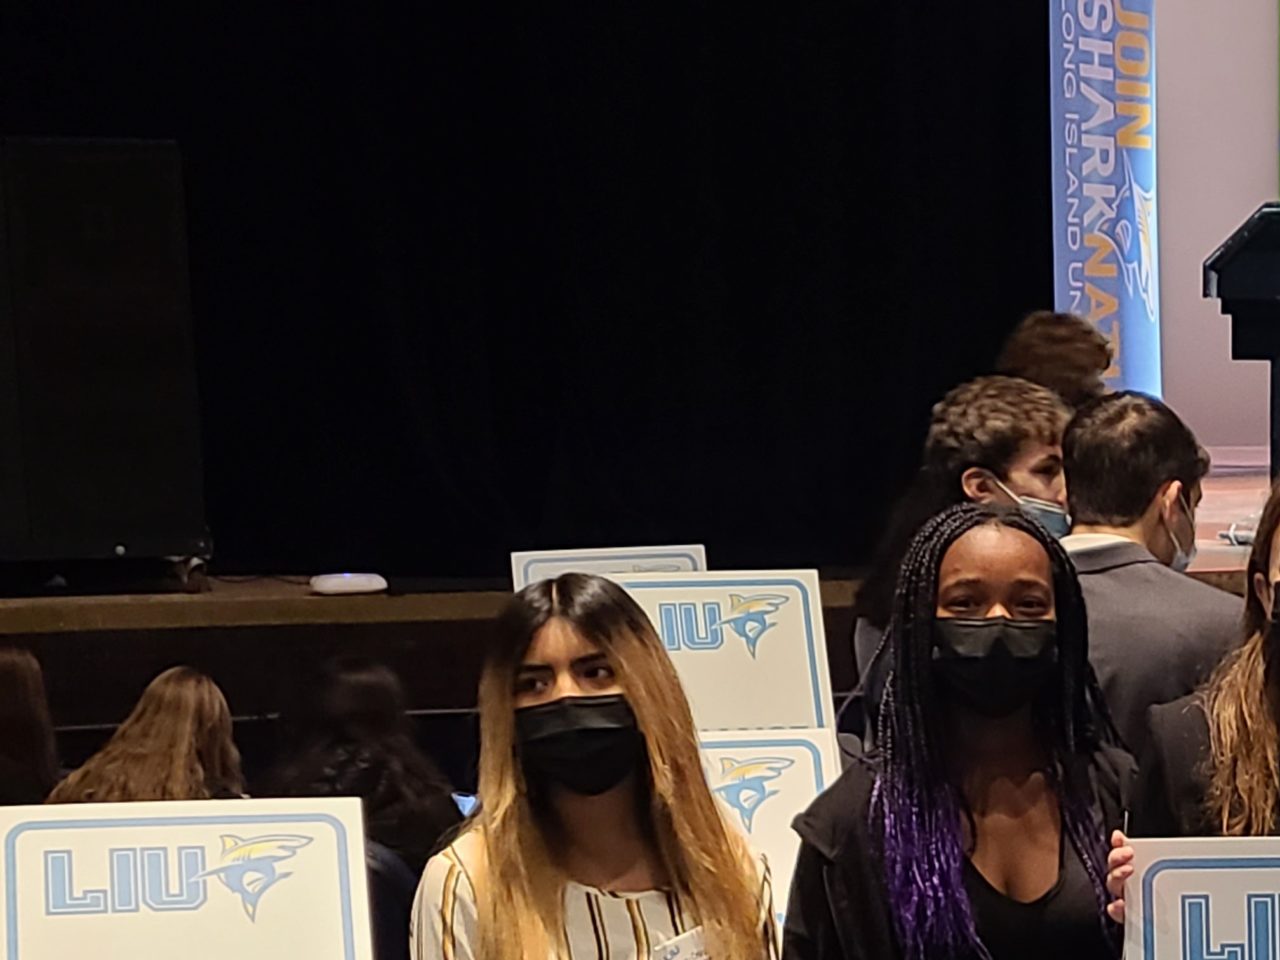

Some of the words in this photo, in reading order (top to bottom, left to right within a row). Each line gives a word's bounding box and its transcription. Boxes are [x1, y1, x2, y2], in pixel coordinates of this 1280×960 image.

[1113, 0, 1152, 149] JOIN
[1064, 113, 1081, 251] ISLAND
[659, 602, 724, 652] IU
[44, 845, 208, 917] LIU
